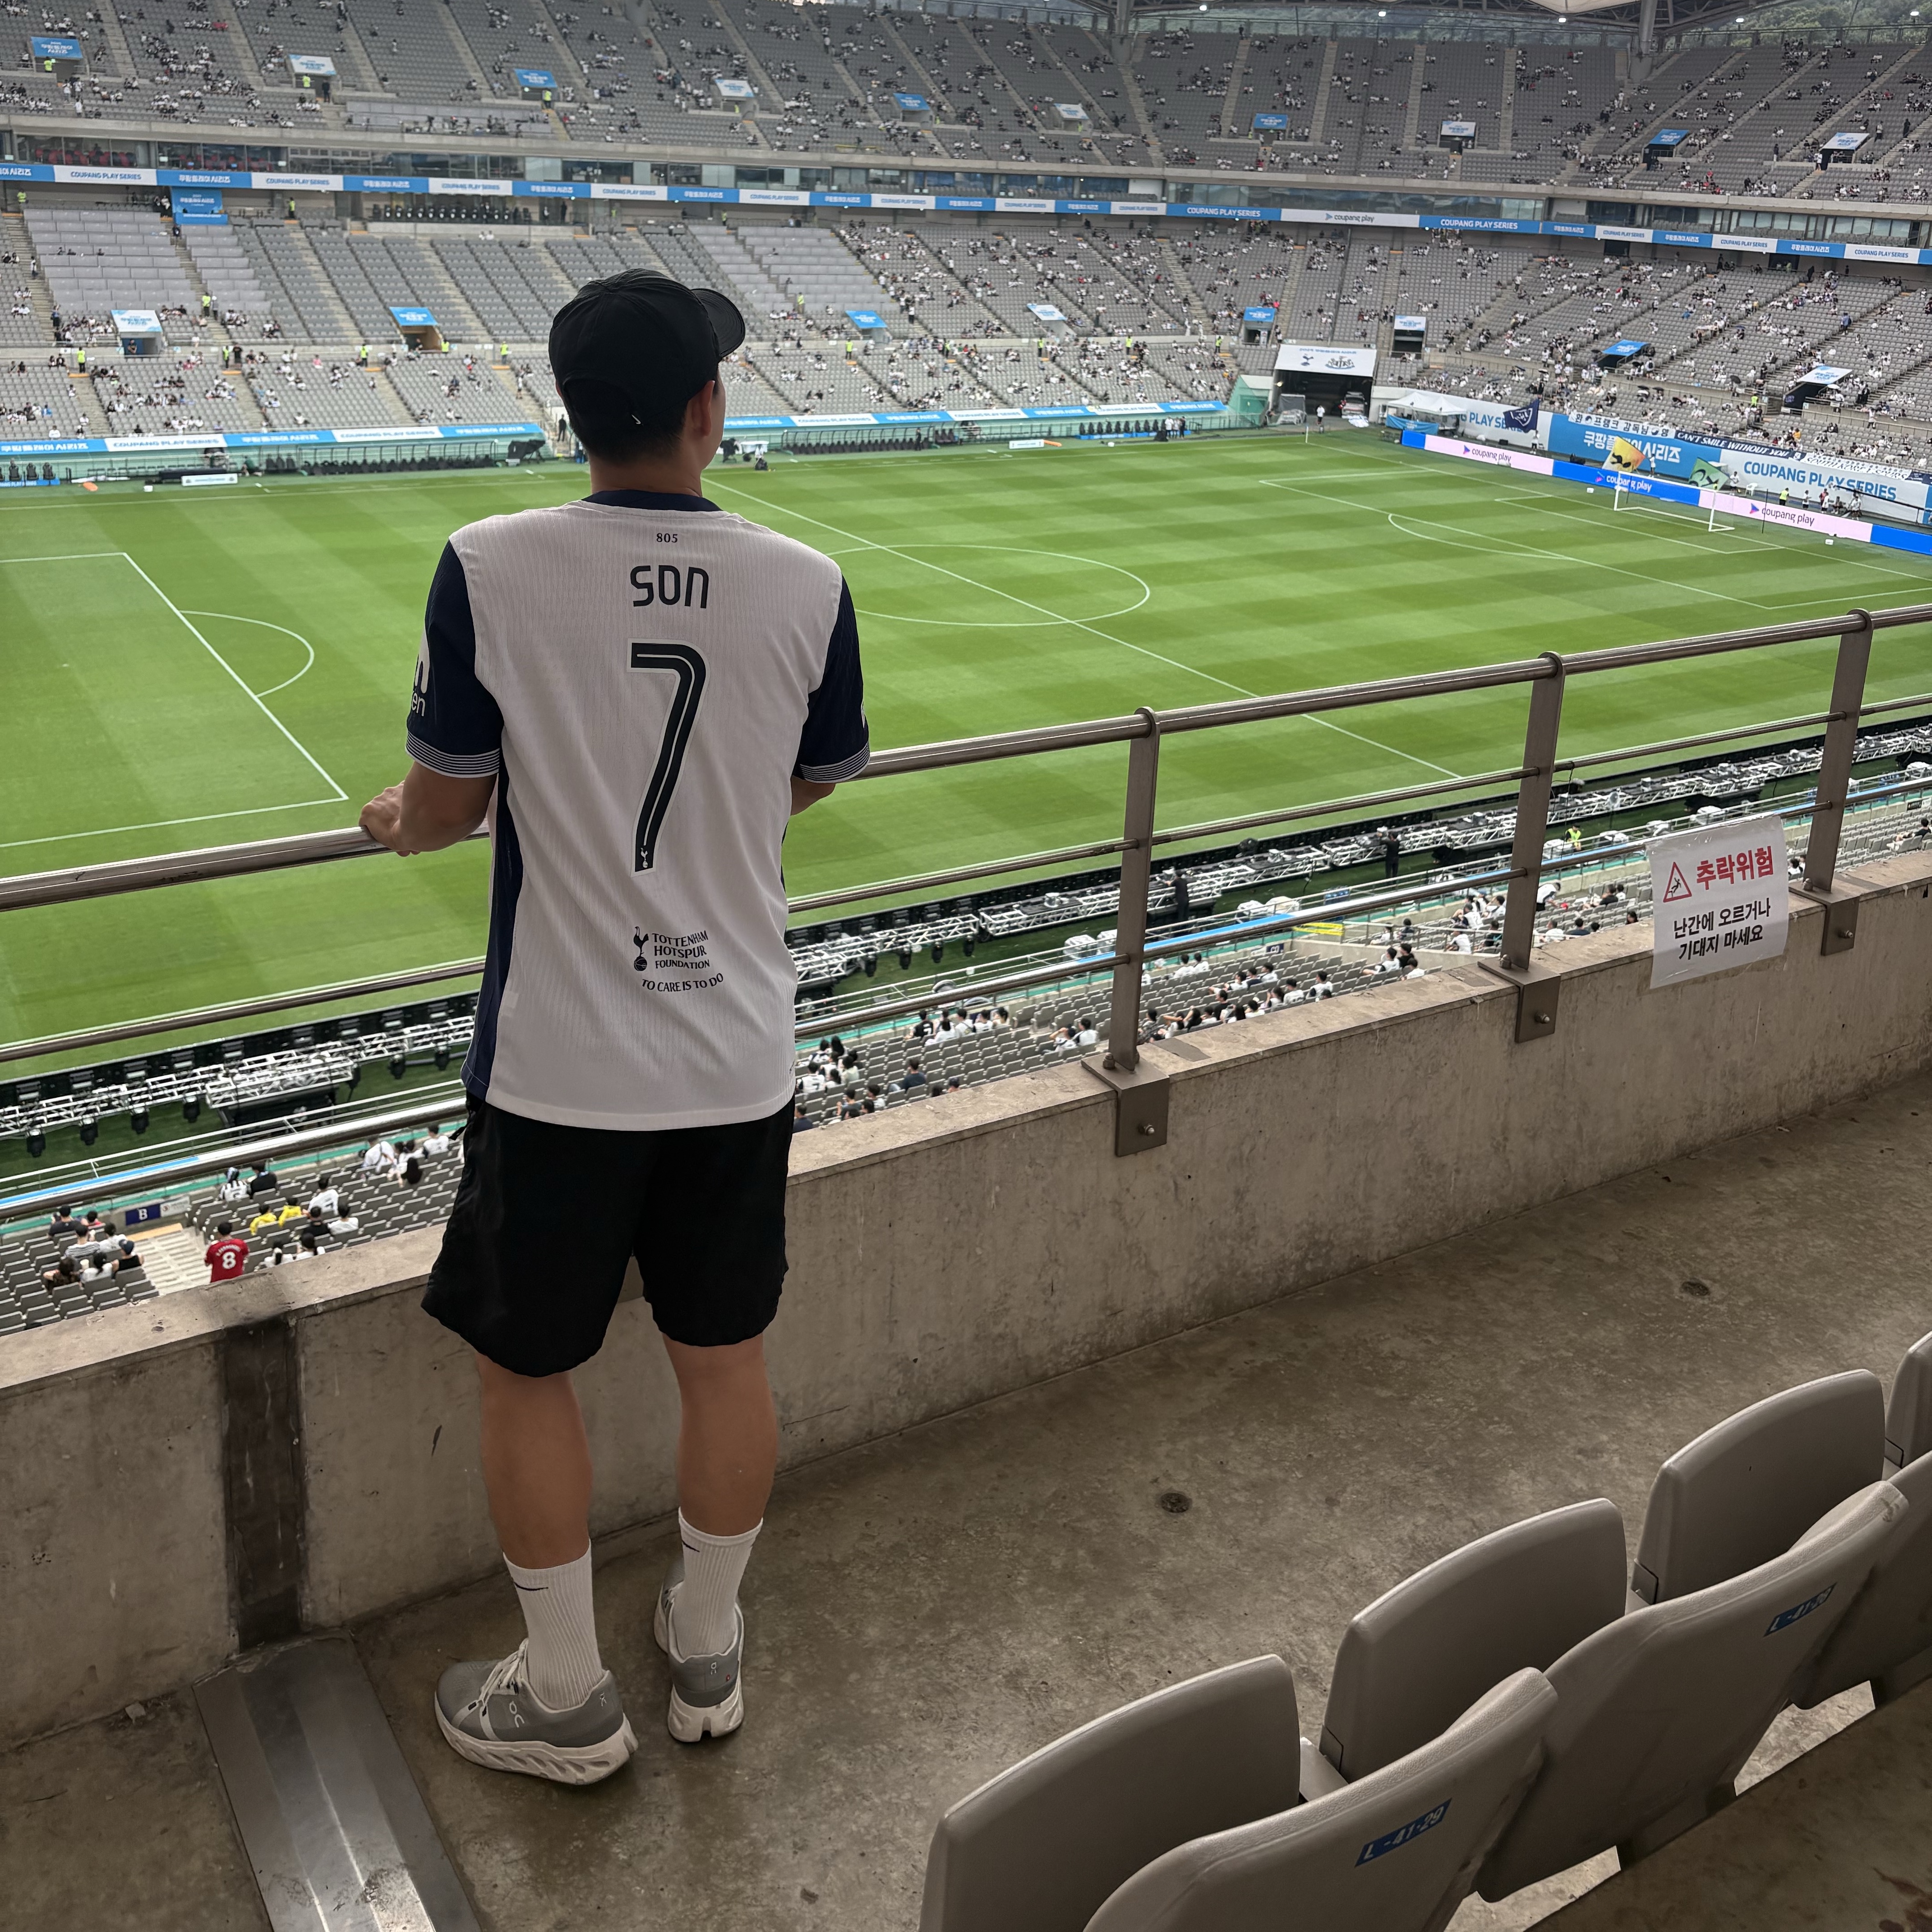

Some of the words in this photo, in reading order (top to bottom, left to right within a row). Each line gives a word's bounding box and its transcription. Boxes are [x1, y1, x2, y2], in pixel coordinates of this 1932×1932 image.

[1187, 207, 1219, 216] COUPANG
[1237, 209, 1261, 217] SERIES
[1334, 214, 1360, 223] coupang
[1361, 215, 1374, 223] play
[1440, 219, 1474, 227] COUPANG
[1475, 220, 1493, 228] PLAY
[1493, 221, 1518, 230] SERIES
[1470, 412, 1494, 427] PLAY
[1594, 417, 1619, 429] 프랭크
[1623, 422, 1649, 435] 감독님
[1472, 448, 1497, 461] coupang
[1498, 452, 1512, 462] play
[1642, 442, 1682, 463] 시리즈
[1701, 437, 1727, 448] SMILE
[1727, 441, 1769, 454] WITHOUT
[1769, 449, 1789, 457] YOU
[1637, 481, 1652, 493] play
[1744, 461, 1806, 484] COUPANG
[1809, 472, 1845, 488] PLAY
[1846, 479, 1896, 501] SERIES
[1761, 508, 1796, 523] coupang
[1798, 514, 1815, 527] play
[656, 533, 678, 543] 805
[630, 565, 709, 608] SON
[630, 641, 707, 874] 7
[1697, 846, 1773, 890] 추락위험
[1674, 911, 1714, 939] 난간에
[1718, 897, 1771, 927] 오르거나
[652, 930, 709, 947] TOTTENHAM
[1678, 934, 1719, 960] 기대지
[1724, 925, 1763, 949] 마세요
[654, 945, 707, 959] HOTSPUR
[655, 959, 710, 969] FOUNDATION
[642, 979, 655, 990] TO
[657, 982, 681, 992] CARE
[682, 980, 692, 991] IS
[693, 980, 708, 989] TO
[709, 972, 724, 987] DO
[138, 1209, 148, 1220] B
[222, 1251, 236, 1270] 8
[1770, 1616, 1780, 1632] L
[1363, 1843, 1374, 1860] L
